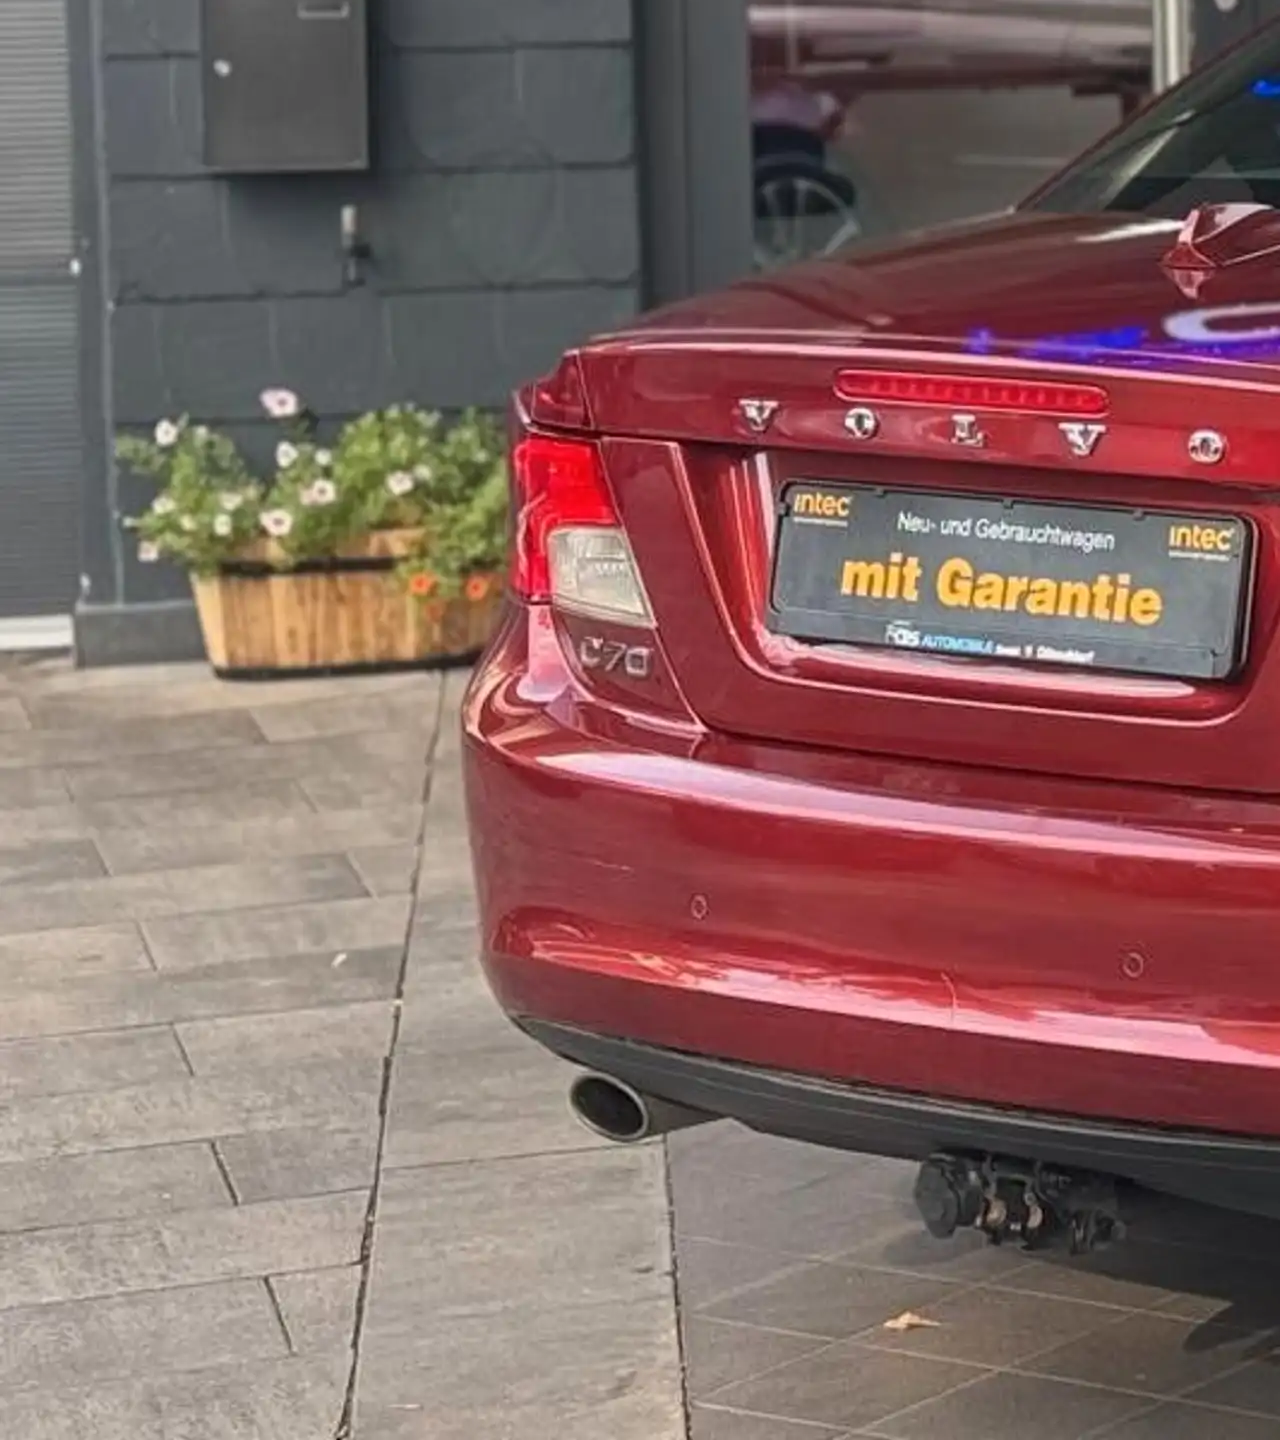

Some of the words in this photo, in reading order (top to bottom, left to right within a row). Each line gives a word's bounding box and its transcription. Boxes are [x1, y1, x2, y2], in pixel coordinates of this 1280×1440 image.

[738, 398, 1227, 464] VOLVO
[794, 492, 849, 517] intec
[897, 510, 936, 533] Neu-
[940, 517, 972, 537] und
[974, 518, 1115, 553] Gebrauchtwagen
[1169, 524, 1234, 551] intec
[841, 552, 922, 601] mit
[937, 557, 1163, 625] Garantie
[580, 636, 652, 676] C70
